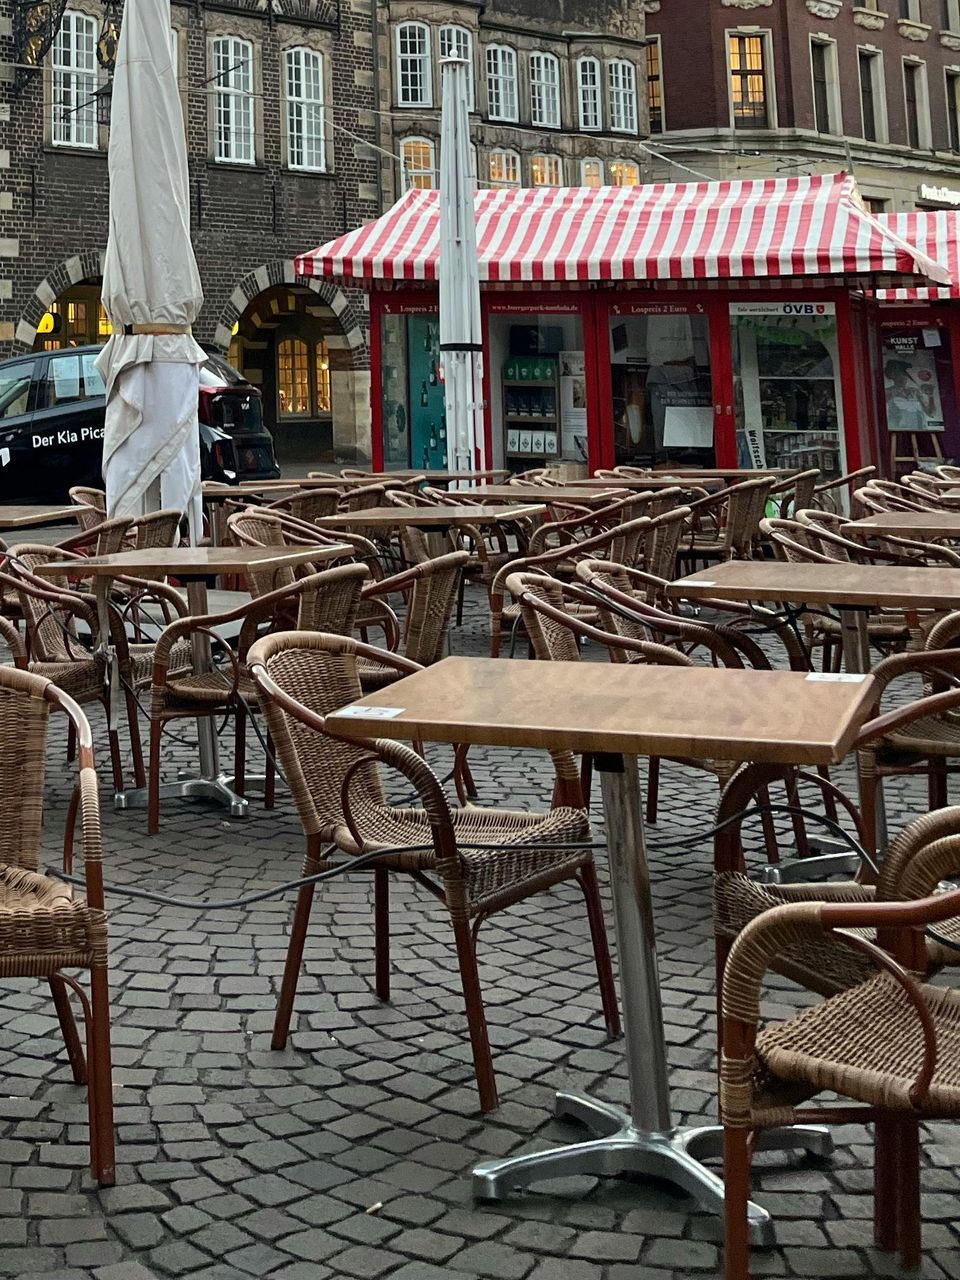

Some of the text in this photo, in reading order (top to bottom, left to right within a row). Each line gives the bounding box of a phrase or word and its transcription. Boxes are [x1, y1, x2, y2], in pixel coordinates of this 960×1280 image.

[631, 305, 661, 314] Lospreis
[669, 305, 687, 313] Euro
[783, 303, 814, 314] ÖVB
[890, 337, 919, 345] KUNST
[32, 434, 55, 449] Der
[57, 429, 78, 445] Kia
